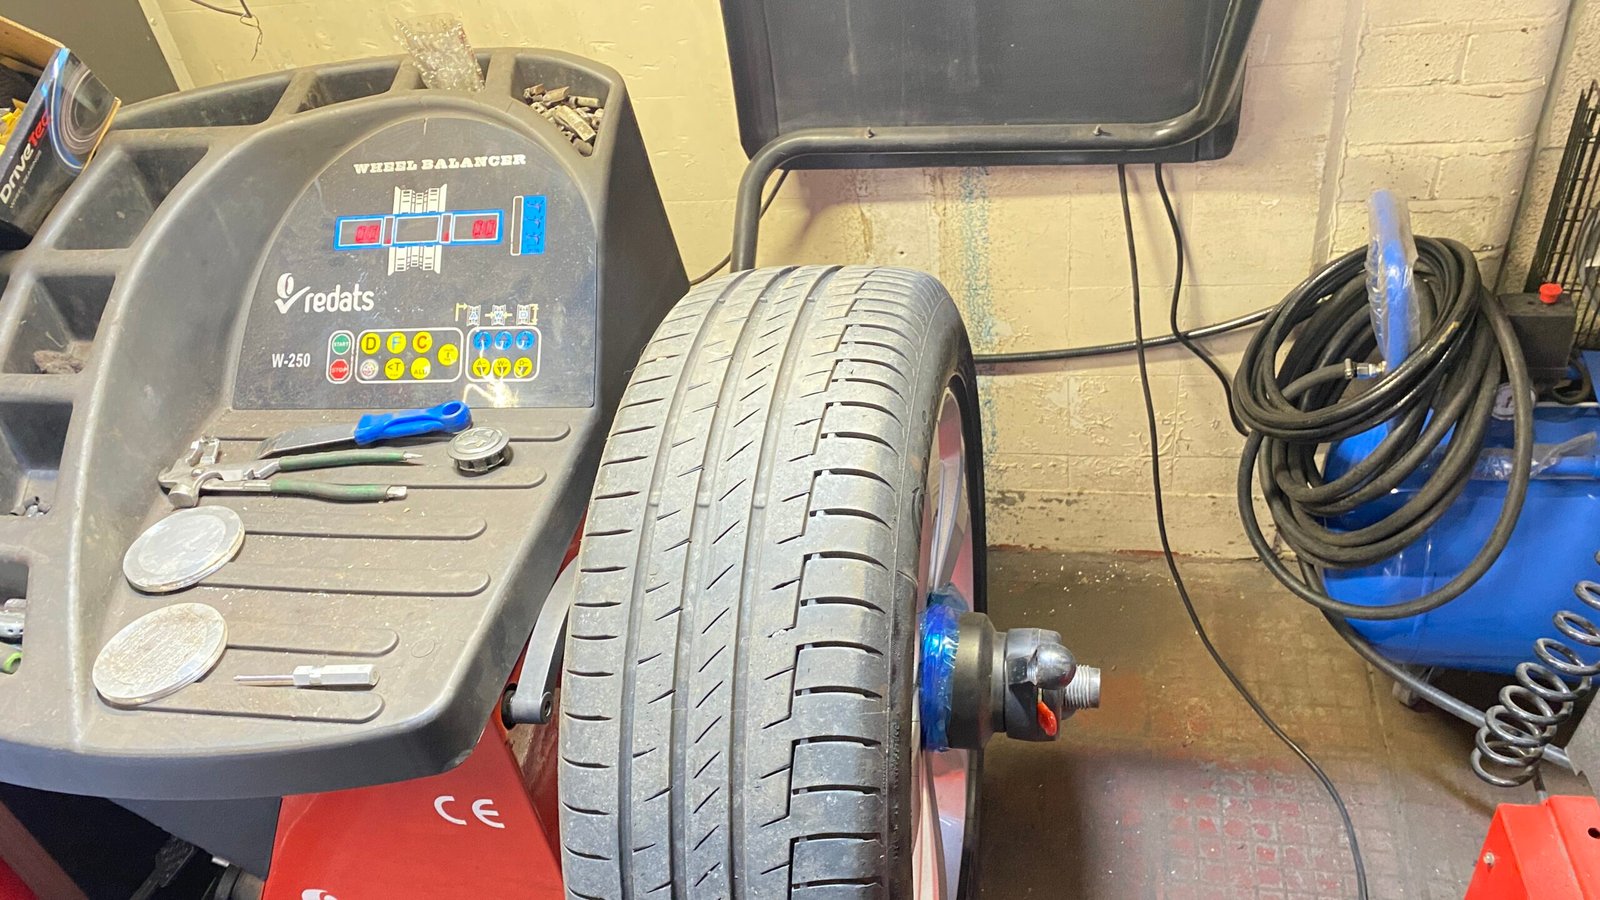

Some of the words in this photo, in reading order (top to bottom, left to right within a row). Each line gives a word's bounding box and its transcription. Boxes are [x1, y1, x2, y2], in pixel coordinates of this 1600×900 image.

[353, 161, 418, 174] WHEEL
[421, 154, 527, 171] BALANCER
[304, 283, 375, 313] redats
[366, 337, 376, 350] D
[416, 335, 427, 349] C
[271, 353, 311, 368] W-250
[434, 795, 505, 829] CE
